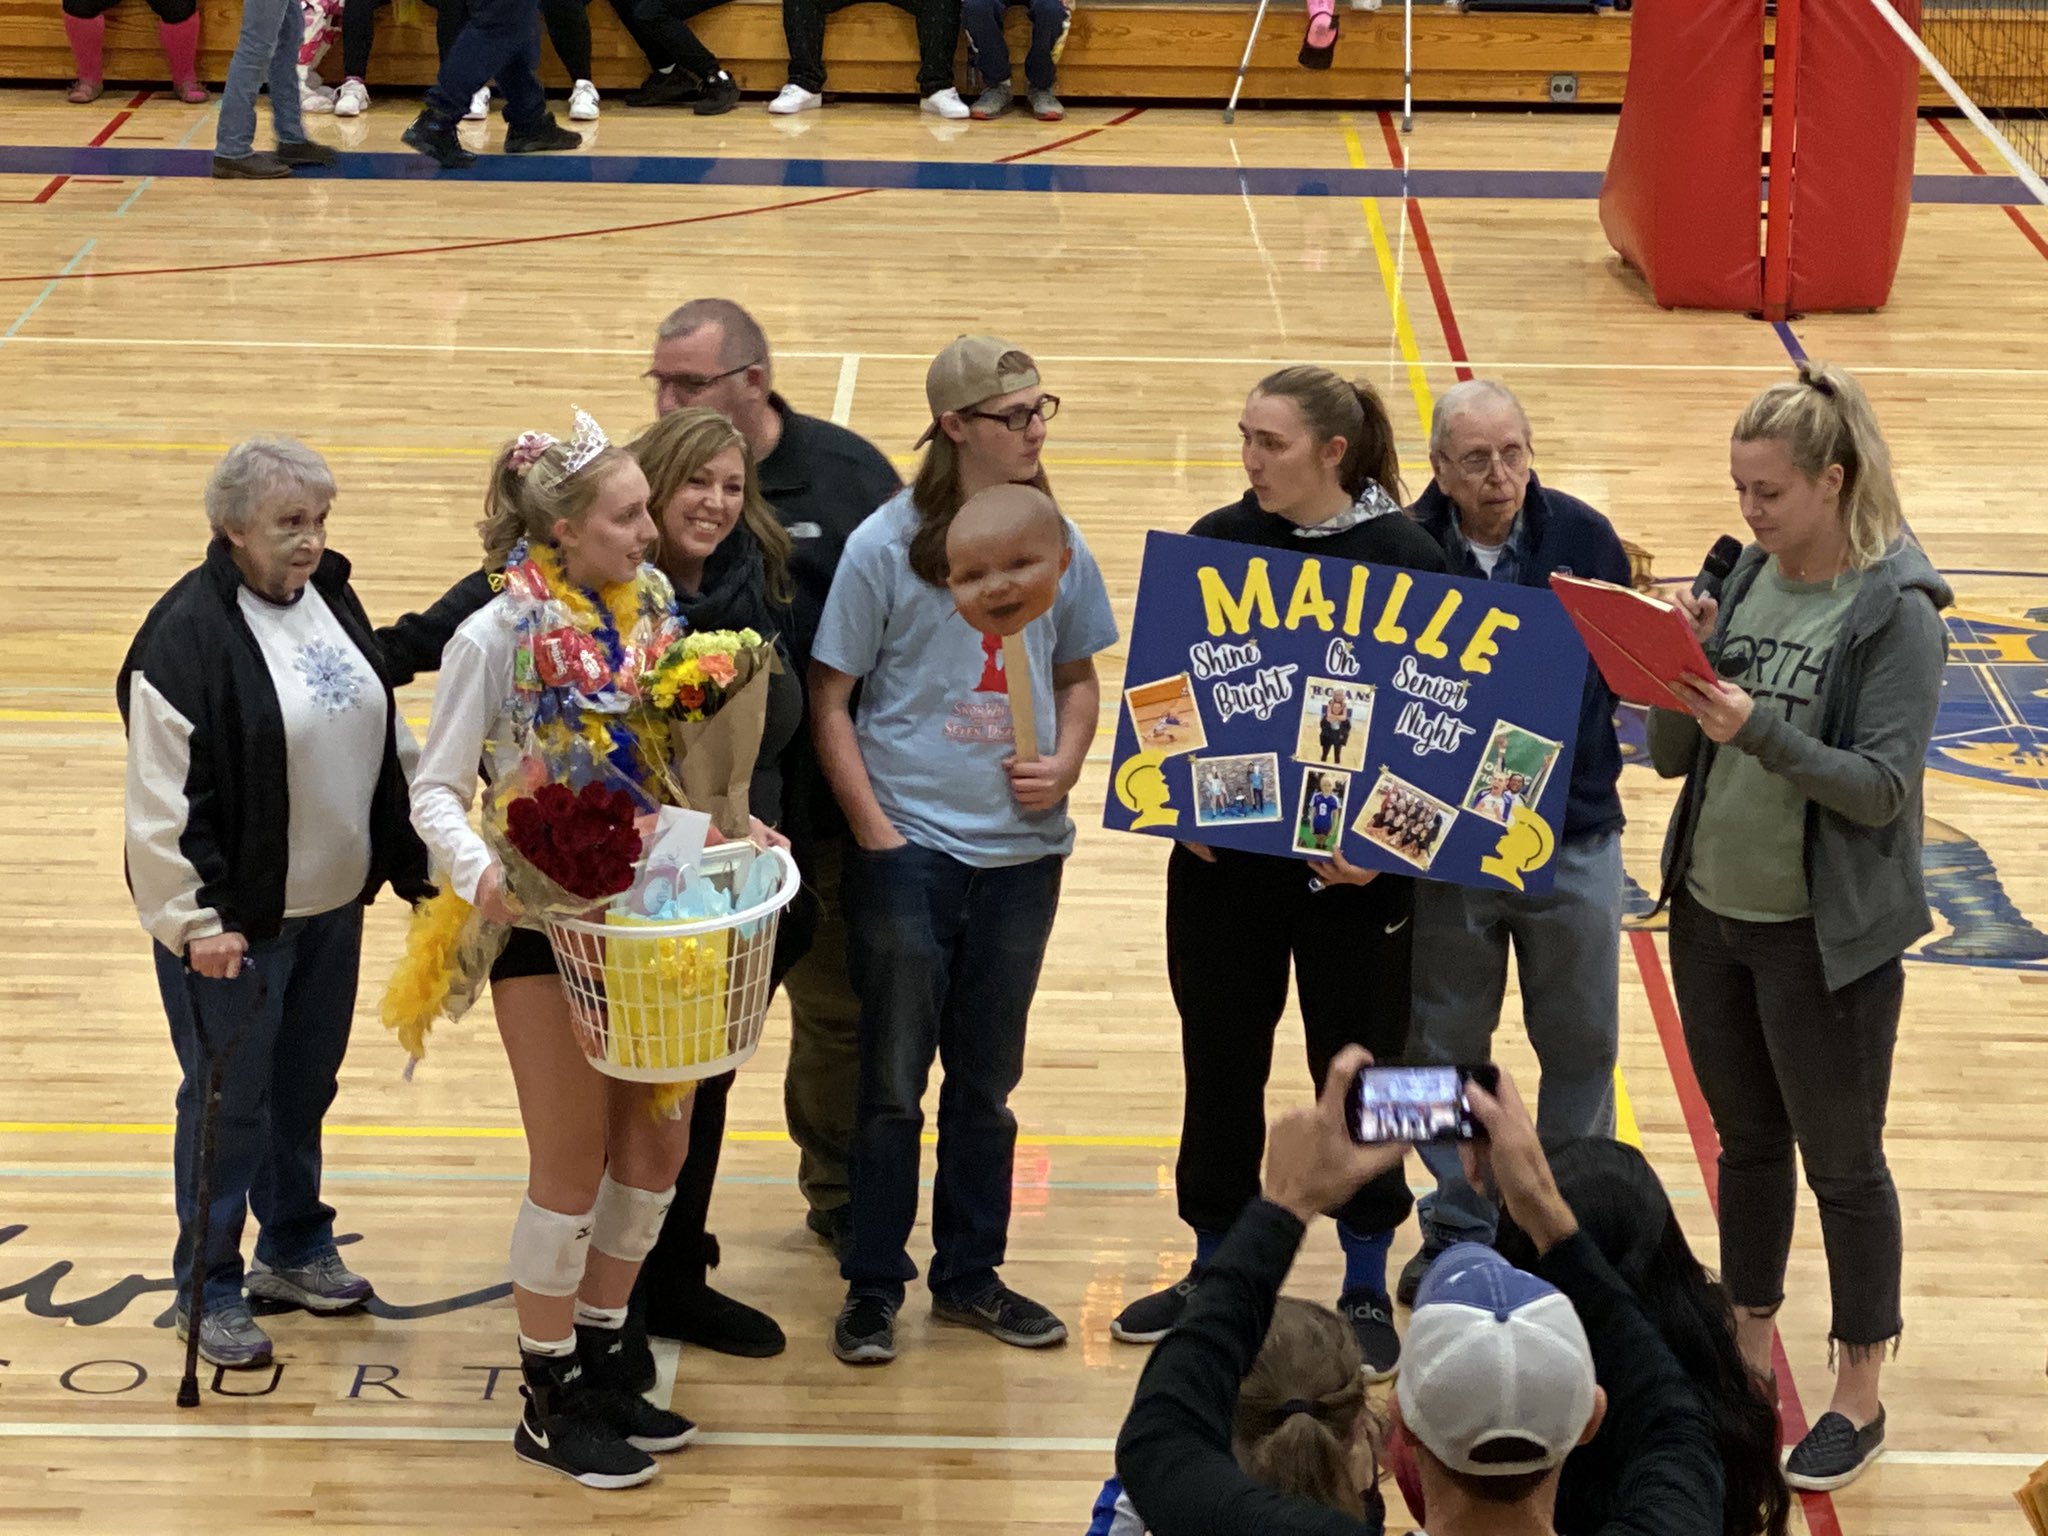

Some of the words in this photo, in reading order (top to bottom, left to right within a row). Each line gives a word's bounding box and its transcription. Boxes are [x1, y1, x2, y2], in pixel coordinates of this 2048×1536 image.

[1196, 556, 1521, 675] MAILLE
[1190, 641, 1260, 680] Shine
[1327, 638, 1360, 675] On
[1393, 656, 1467, 711] Senior
[1717, 629, 1834, 695] ORTH
[1214, 664, 1297, 720] Bright
[1396, 701, 1476, 754] Night
[0, 1359, 521, 1401] OURT
